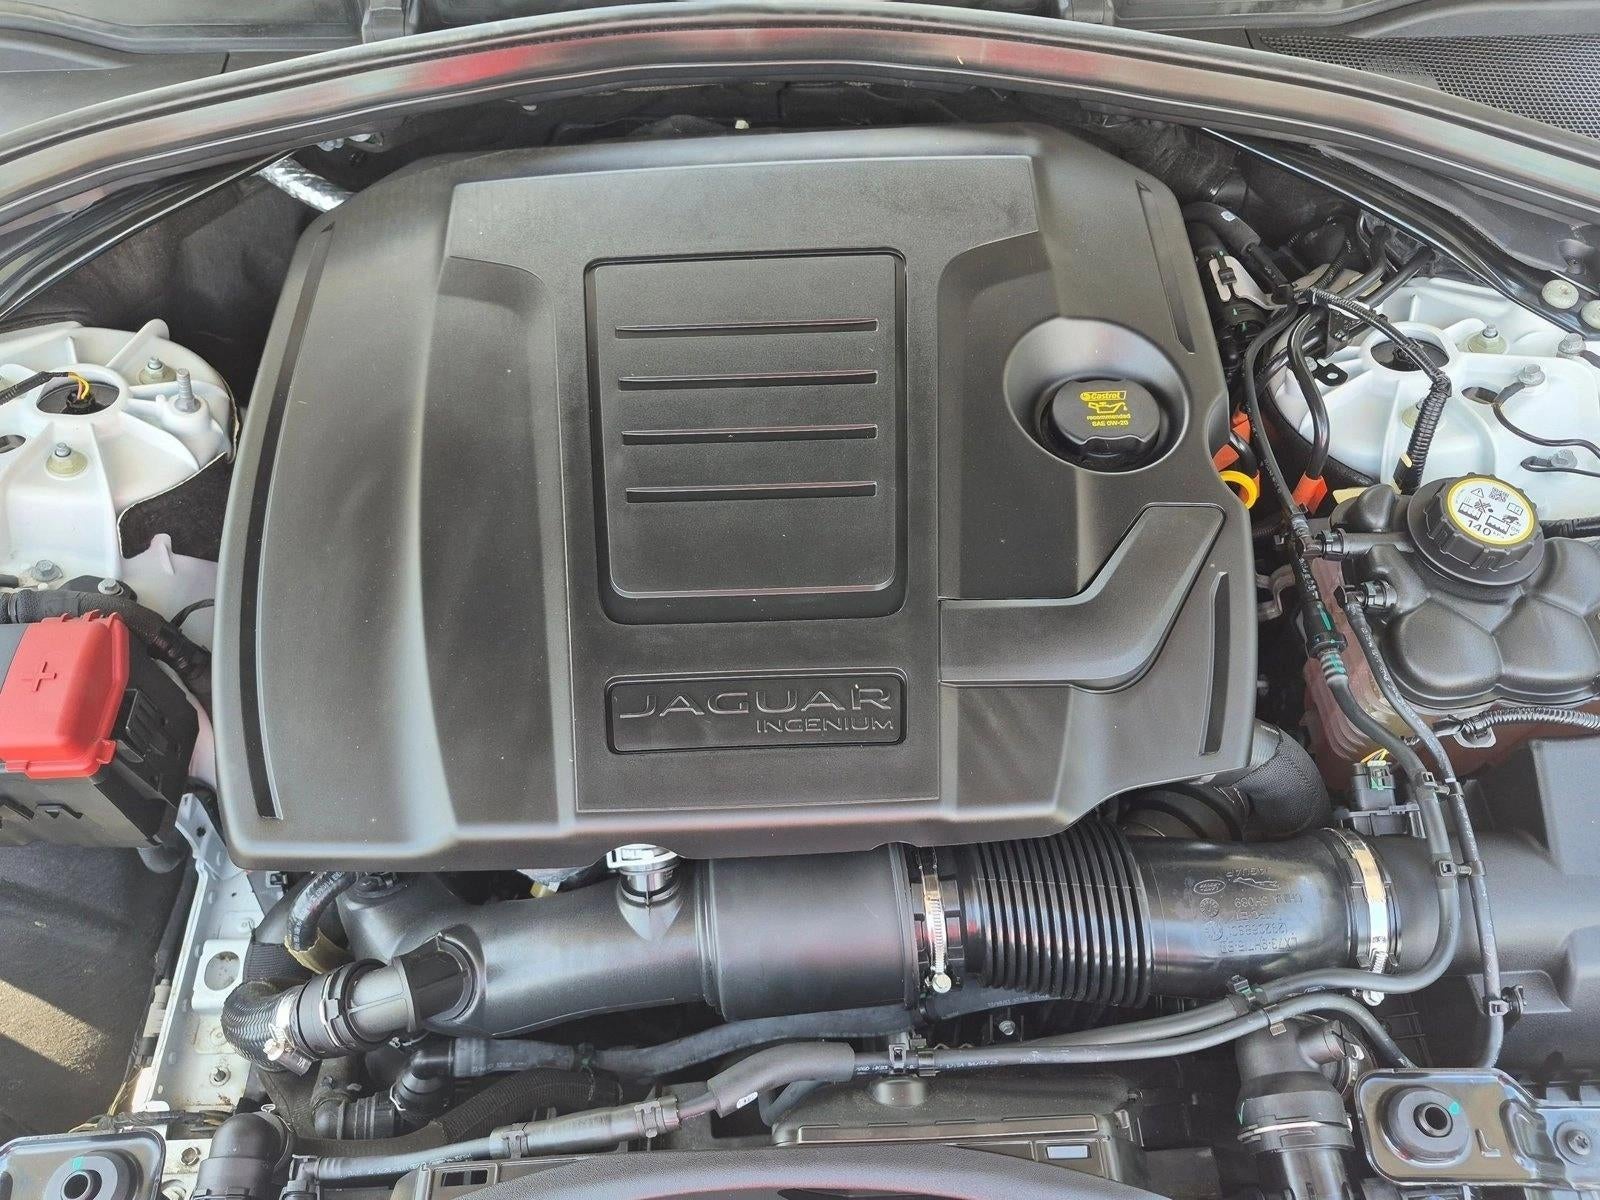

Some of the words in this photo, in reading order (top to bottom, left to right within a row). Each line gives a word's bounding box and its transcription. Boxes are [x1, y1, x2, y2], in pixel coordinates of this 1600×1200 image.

[1091, 392, 1120, 400] Castrol
[1467, 520, 1492, 536] 140
[619, 684, 892, 719] JAGUAR
[755, 717, 894, 734] INGENIUM
